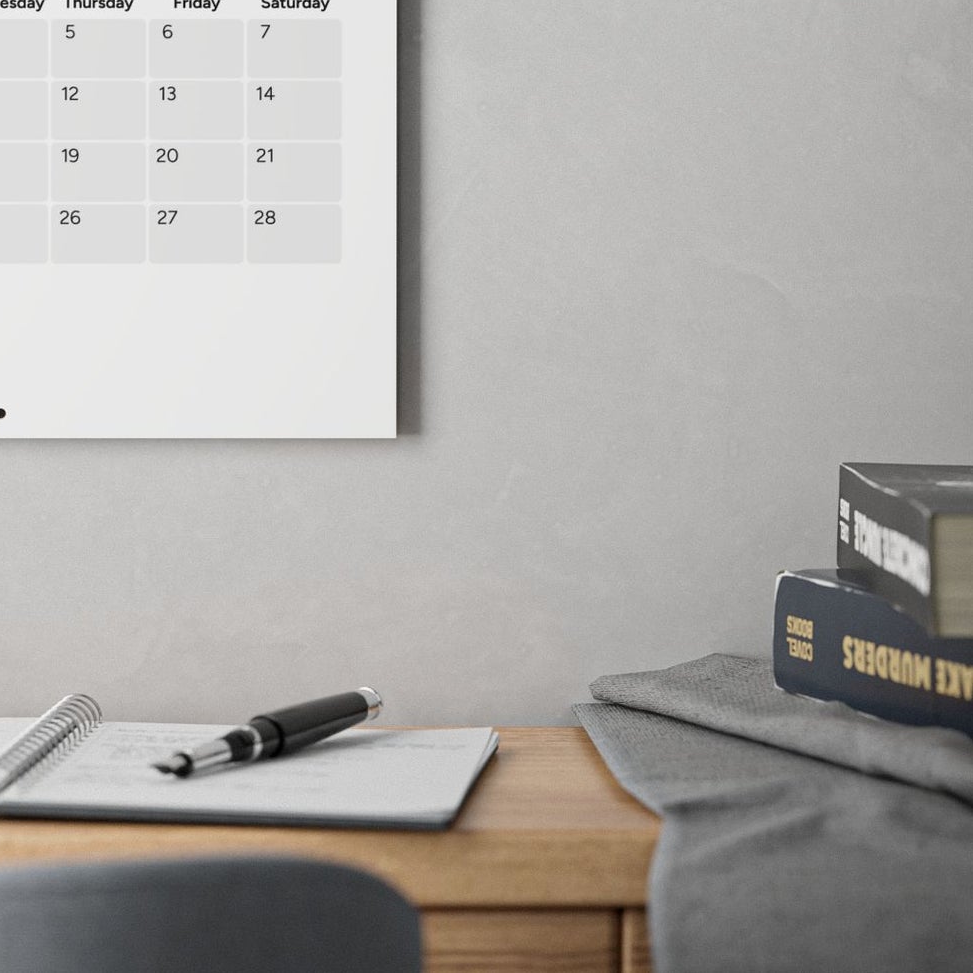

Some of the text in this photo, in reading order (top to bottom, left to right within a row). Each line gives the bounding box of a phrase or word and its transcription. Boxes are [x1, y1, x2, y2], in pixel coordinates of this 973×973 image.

[65, 23, 76, 40] 5
[161, 23, 174, 40] 6
[259, 23, 271, 40] 7
[60, 85, 80, 102] 12
[158, 84, 177, 102] 13
[255, 85, 276, 102] 14
[60, 147, 80, 164] 19
[154, 147, 180, 164] 20
[255, 147, 274, 164] 21
[58, 209, 82, 227] 26
[156, 209, 179, 226] 27
[253, 209, 277, 226] 28
[786, 615, 814, 638] BOOKS
[842, 634, 932, 691] MURDERS
